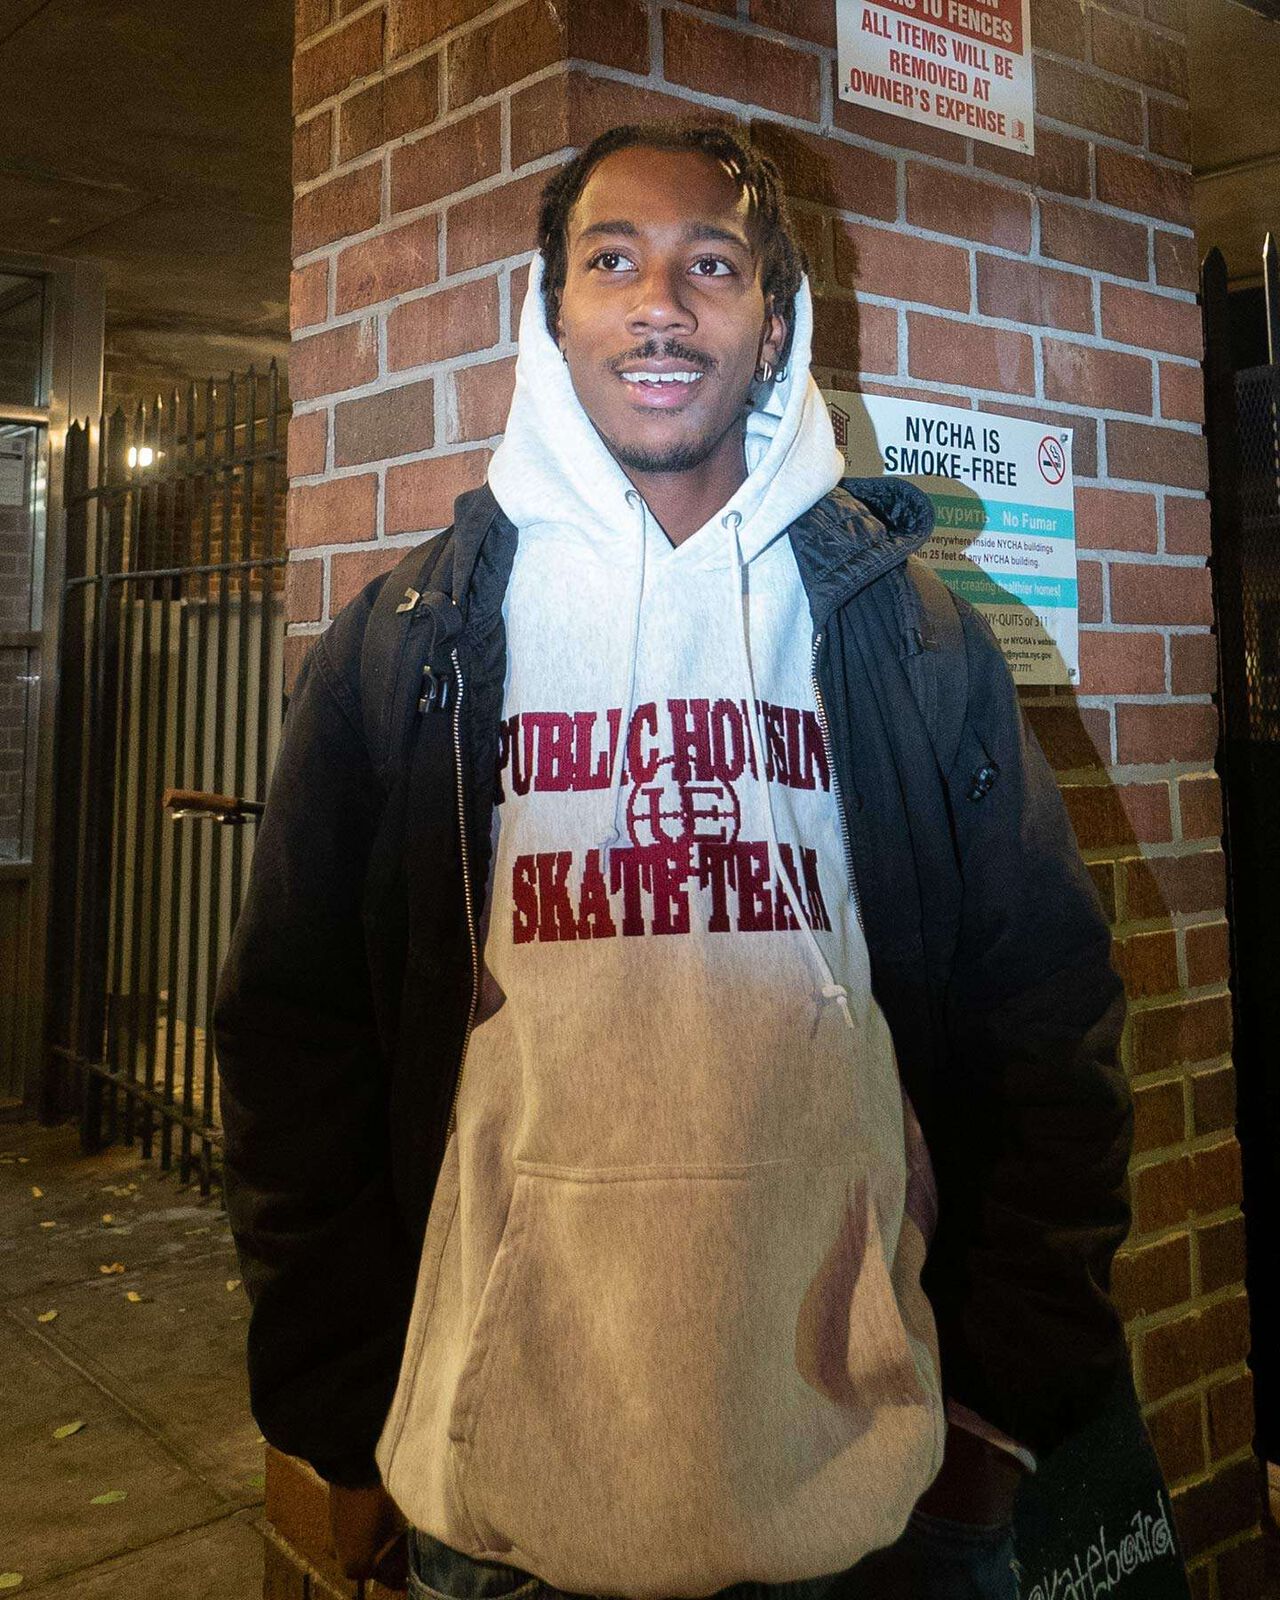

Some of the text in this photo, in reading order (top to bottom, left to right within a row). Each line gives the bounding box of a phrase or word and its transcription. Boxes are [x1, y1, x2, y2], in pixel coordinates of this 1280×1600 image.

[948, 2, 1014, 43] FENCES
[861, 9, 1013, 80] ALL ITEMS WILL BE
[889, 49, 991, 102] REMOVED AT
[850, 68, 1006, 136] OWNER'S EXPENSE
[905, 416, 1000, 454] NYCHA IS
[884, 445, 1017, 487] SMOKE-FREE
[1003, 511, 1058, 531] No Fumar
[930, 550, 940, 560] 25
[941, 550, 957, 561] feet
[958, 551, 967, 561] of
[967, 554, 981, 565] any
[983, 554, 1010, 564] NYCHA
[973, 537, 996, 548] inside
[997, 540, 1023, 550] NYCHA
[1024, 543, 1054, 555] buildings
[1025, 616, 1033, 627] or
[1035, 615, 1048, 628] 311
[513, 841, 832, 944] SKATE TEAM
